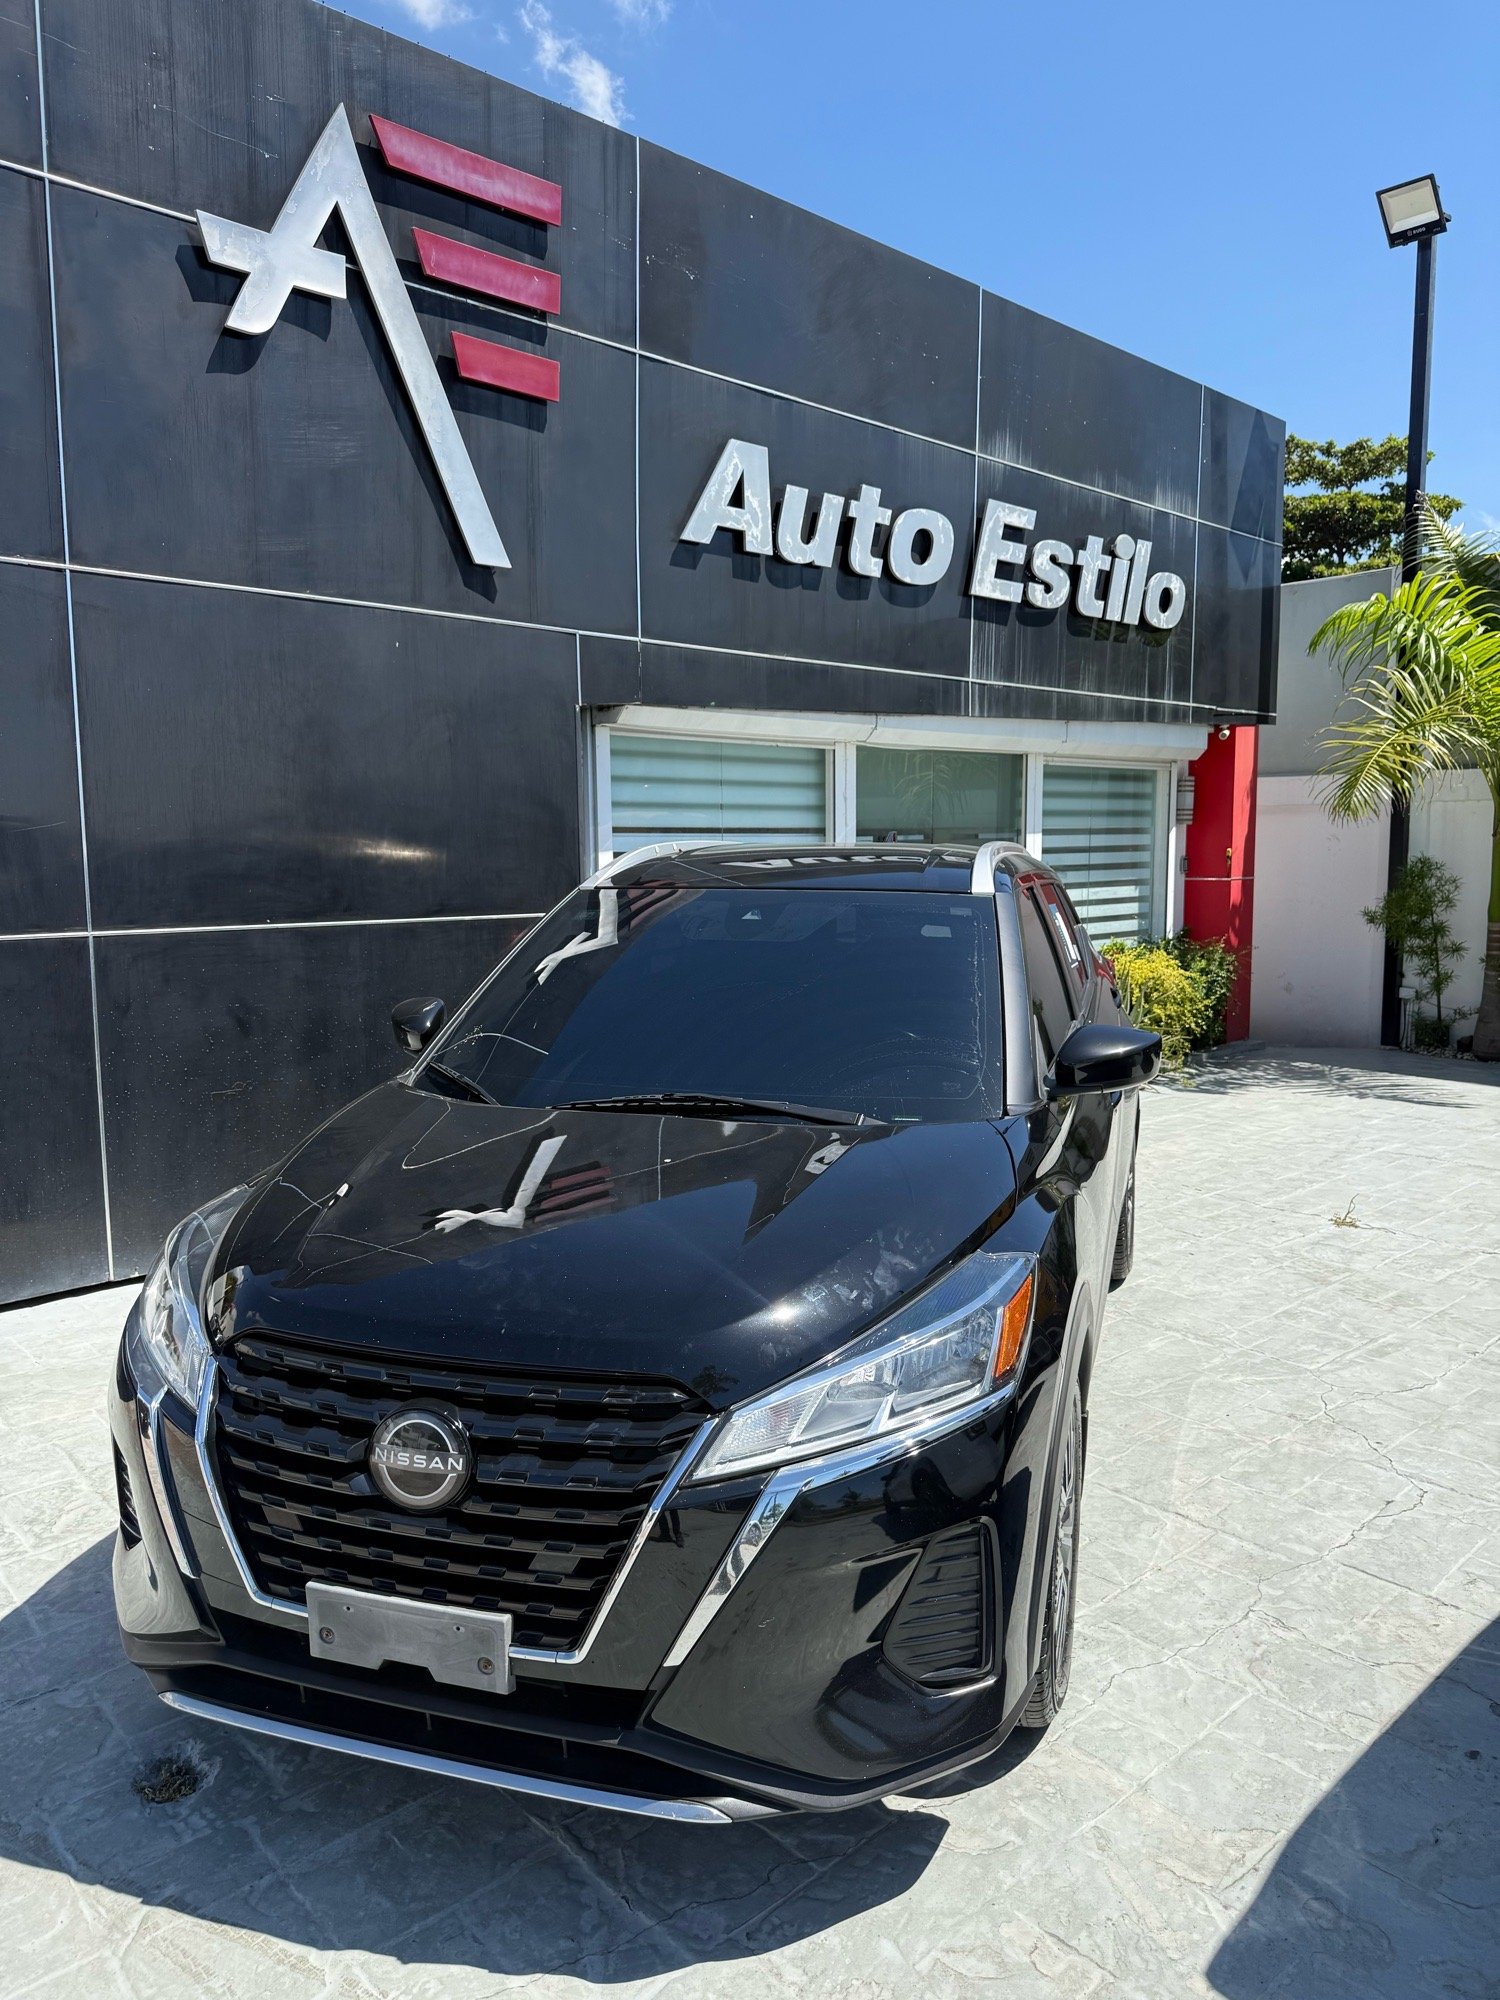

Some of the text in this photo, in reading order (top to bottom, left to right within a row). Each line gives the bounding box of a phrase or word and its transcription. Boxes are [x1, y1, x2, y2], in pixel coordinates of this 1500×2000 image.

[680, 438, 1186, 630] Auto Estilo
[374, 1447, 463, 1471] NISSAN
